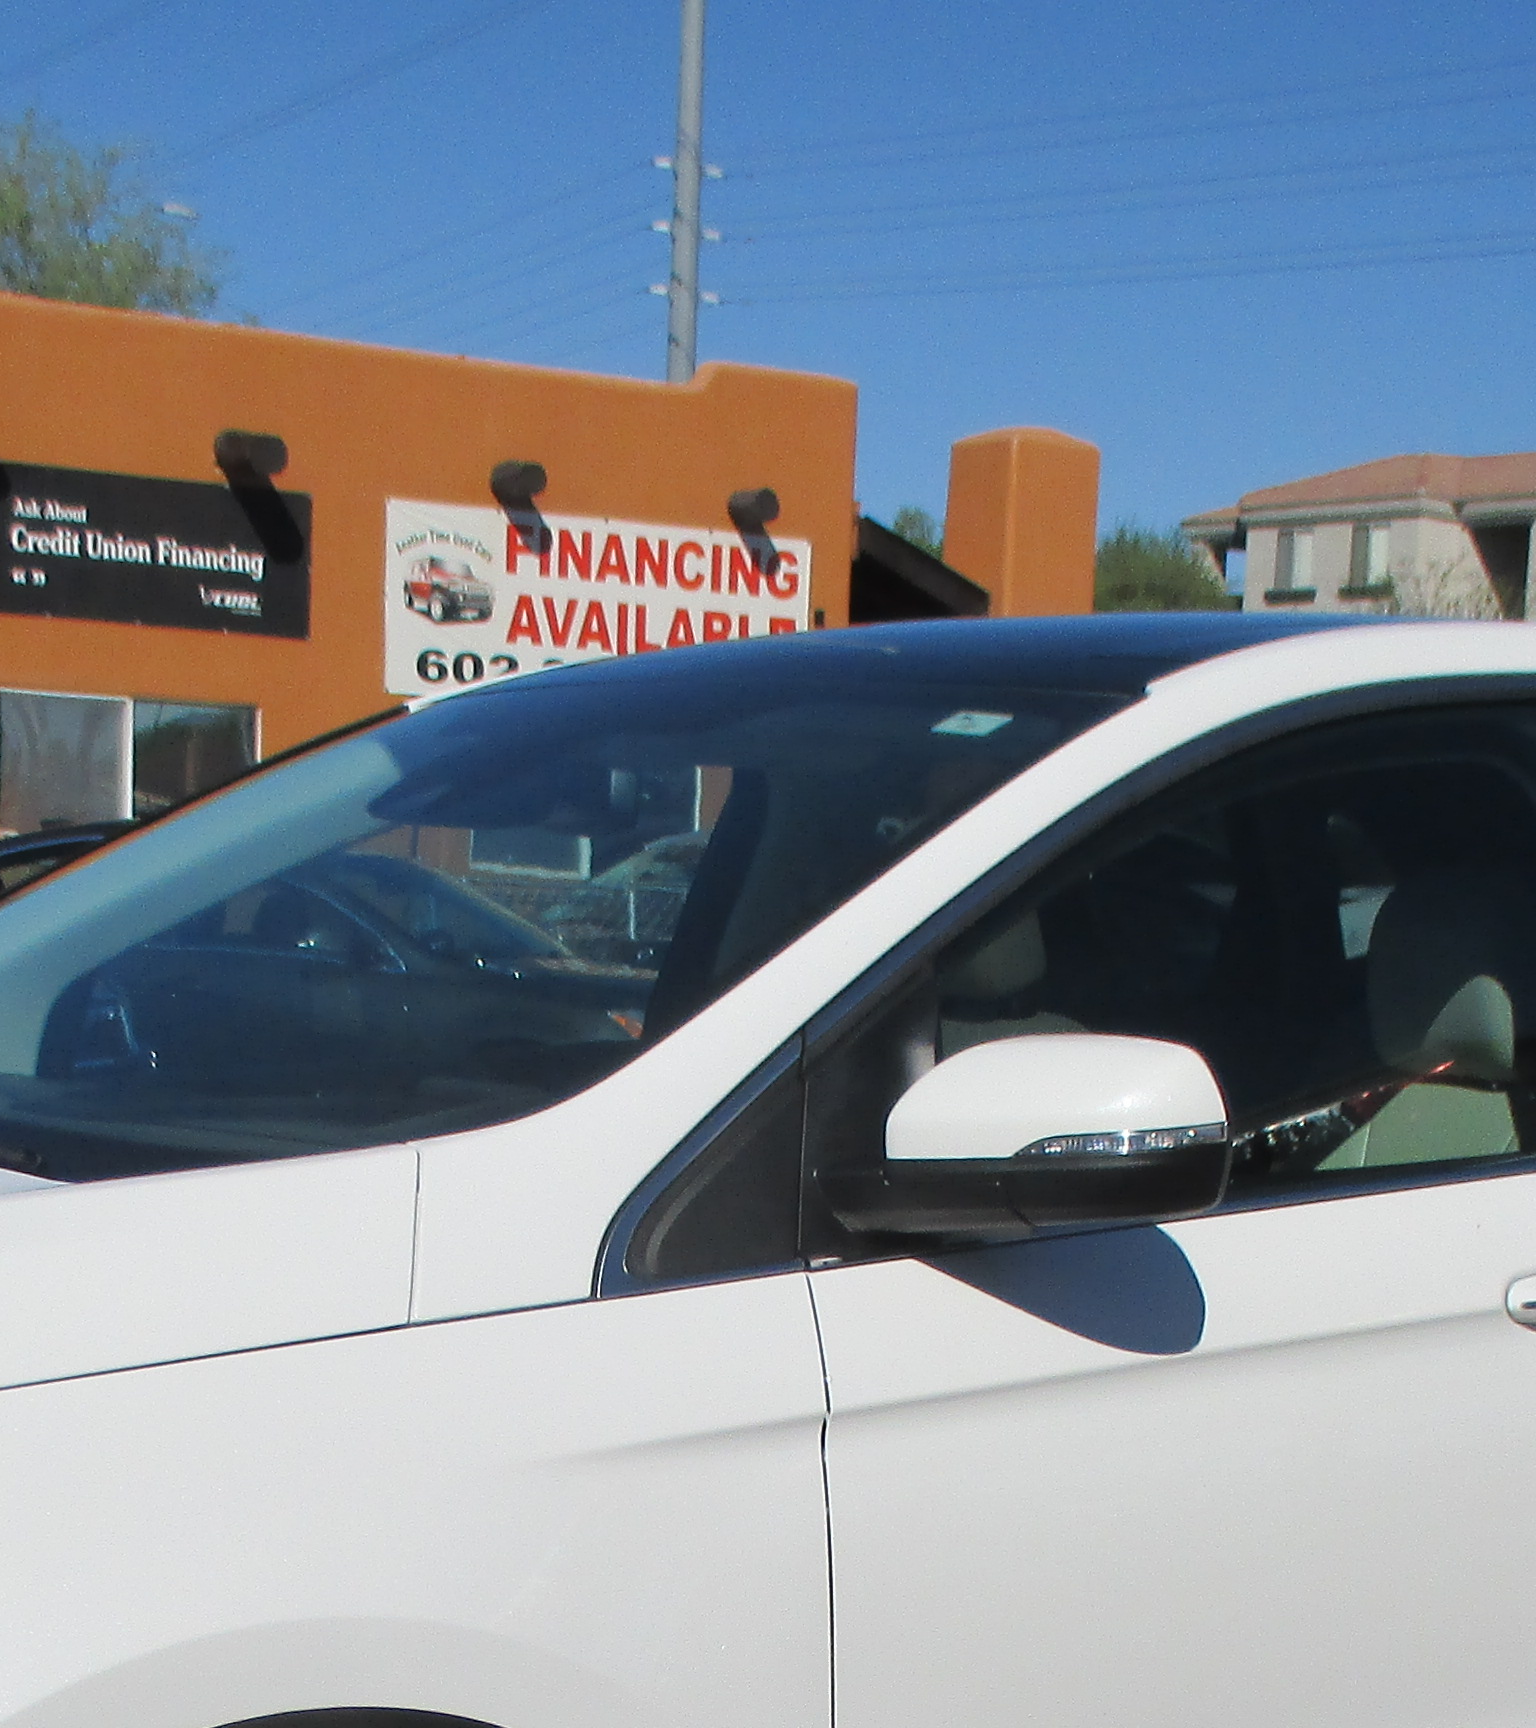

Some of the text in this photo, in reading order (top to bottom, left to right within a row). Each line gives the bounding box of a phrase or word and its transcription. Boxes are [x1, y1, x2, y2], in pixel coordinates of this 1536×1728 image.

[13, 496, 88, 524] Ask About
[9, 523, 265, 581] Credit Union Financing
[506, 524, 799, 599] FINANCING
